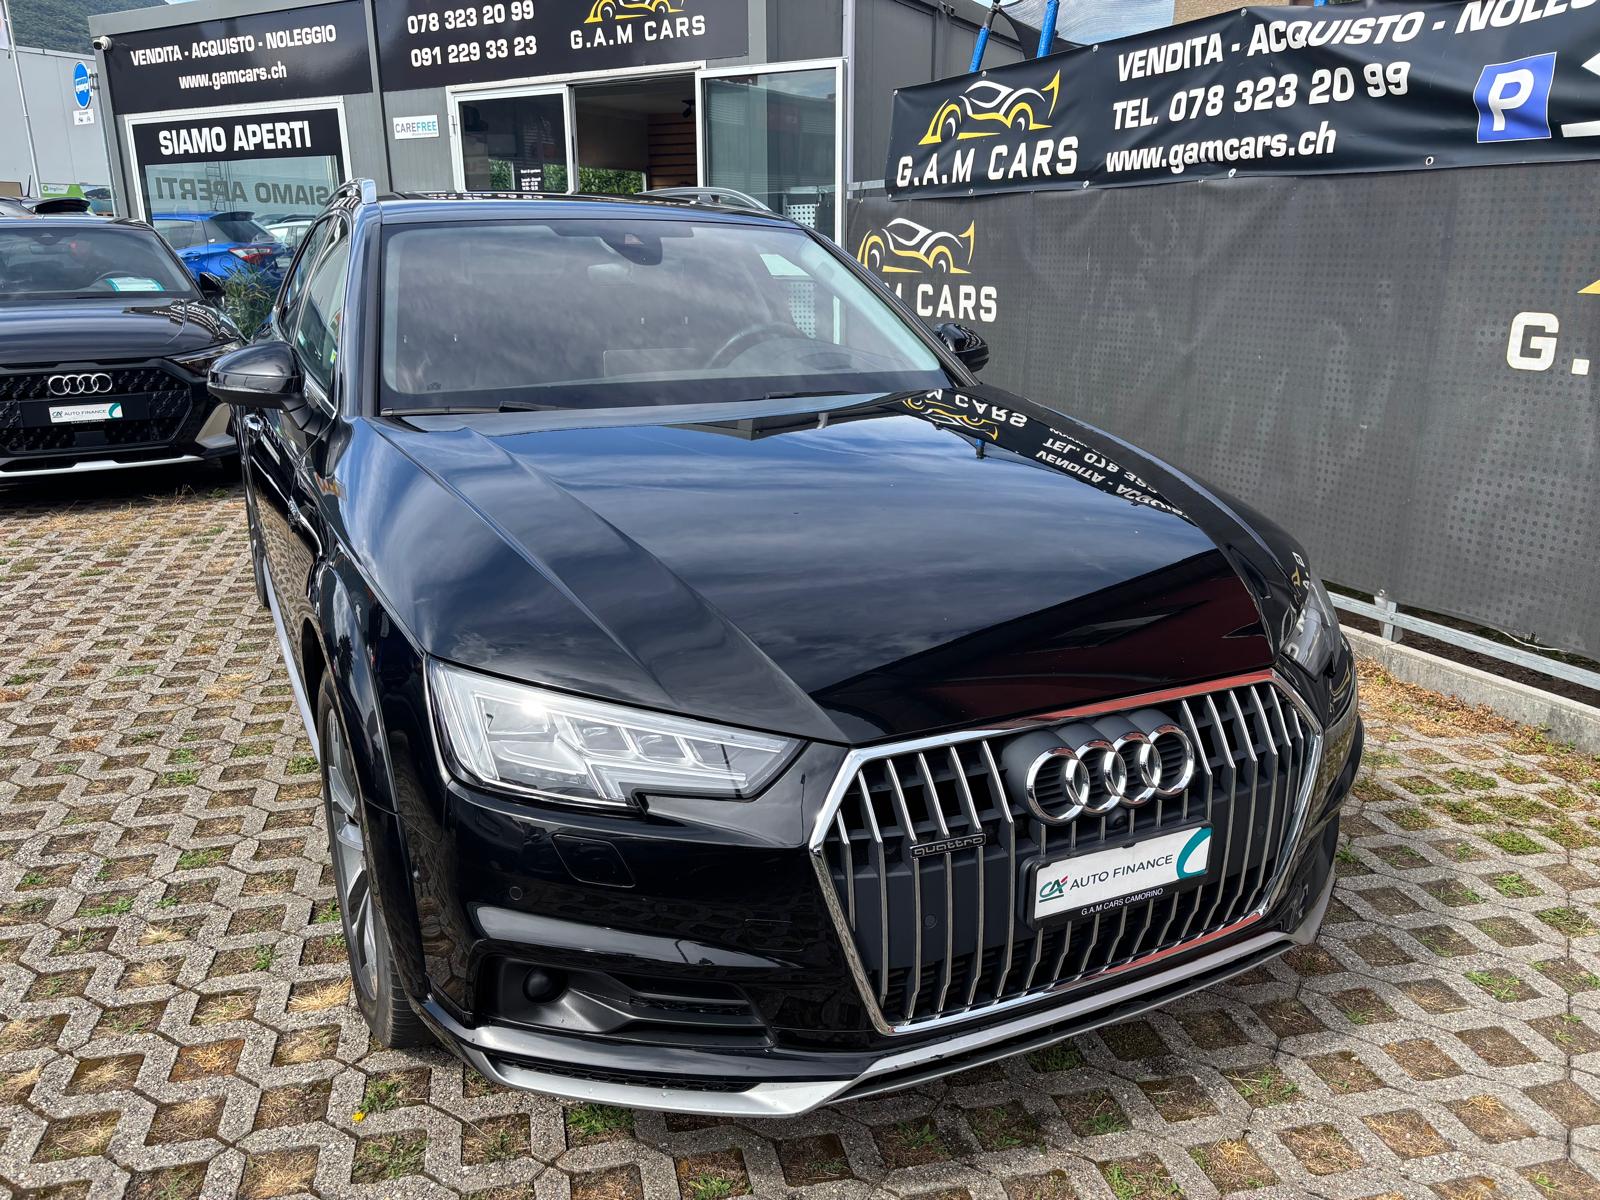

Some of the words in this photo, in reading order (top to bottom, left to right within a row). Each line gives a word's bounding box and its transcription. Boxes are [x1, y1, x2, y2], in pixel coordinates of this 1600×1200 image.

[407, 13, 440, 34] 078
[445, 8, 478, 30] 323
[483, 4, 506, 25] 20
[511, 0, 535, 21] 99
[570, 24, 633, 50] G.A.M
[644, 15, 706, 41] CARS
[130, 45, 183, 66] VENDITA
[191, 35, 256, 59] ACQUISTO
[266, 25, 337, 50] NOLEGGIO
[411, 46, 442, 67] 091
[448, 42, 481, 63] 229
[486, 39, 508, 59] 33
[514, 36, 537, 56] 23
[1118, 33, 1224, 82] VENDITA
[1247, 12, 1426, 57] ACQUISTO
[179, 61, 287, 90] www.gamcars.ch
[1113, 97, 1159, 130] TEL.
[1168, 85, 1225, 123] 078
[1233, 73, 1299, 113] 323
[1308, 67, 1355, 105] 20
[1363, 62, 1411, 97] 99
[1487, 69, 1535, 131] P
[158, 127, 226, 155] SIAMO
[233, 121, 312, 151] APERTI
[395, 121, 437, 133] CAREFREE
[896, 148, 976, 188] G.A.M
[987, 136, 1079, 181] CARS
[1105, 121, 1337, 174] www.gamcars.ch
[917, 284, 997, 323] CARS
[914, 837, 983, 856] quattro
[1070, 871, 1109, 891] AUTO
[1112, 854, 1174, 879] FINANCE
[1081, 904, 1103, 916] G.A.M
[1103, 899, 1124, 911] CARS
[1124, 887, 1164, 904] CAMORINO
